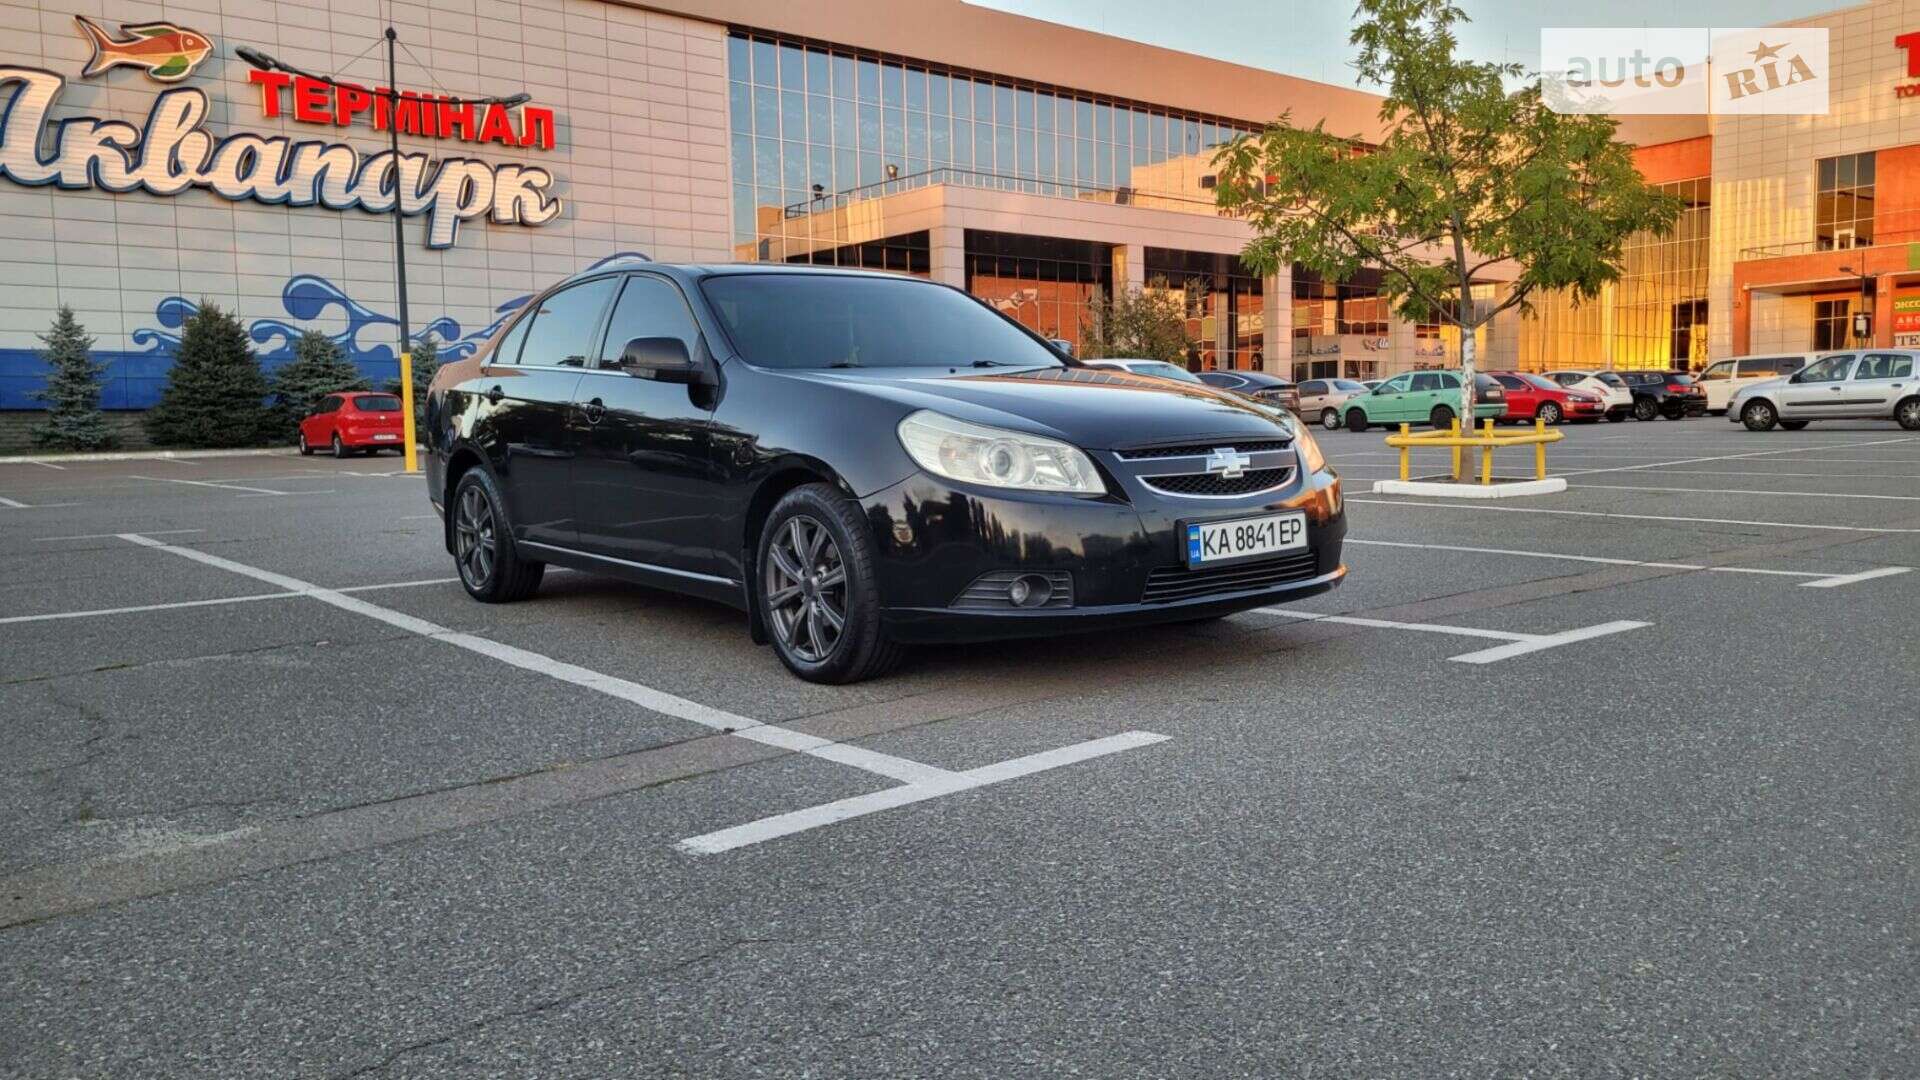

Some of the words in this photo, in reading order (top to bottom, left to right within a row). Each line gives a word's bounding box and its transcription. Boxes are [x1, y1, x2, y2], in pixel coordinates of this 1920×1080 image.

[248, 69, 556, 150] ТЕРМІНАЛ
[1190, 550, 1199, 558] UA
[1203, 527, 1231, 555] KA
[1236, 522, 1275, 551] 8841
[1280, 518, 1301, 545] EP
